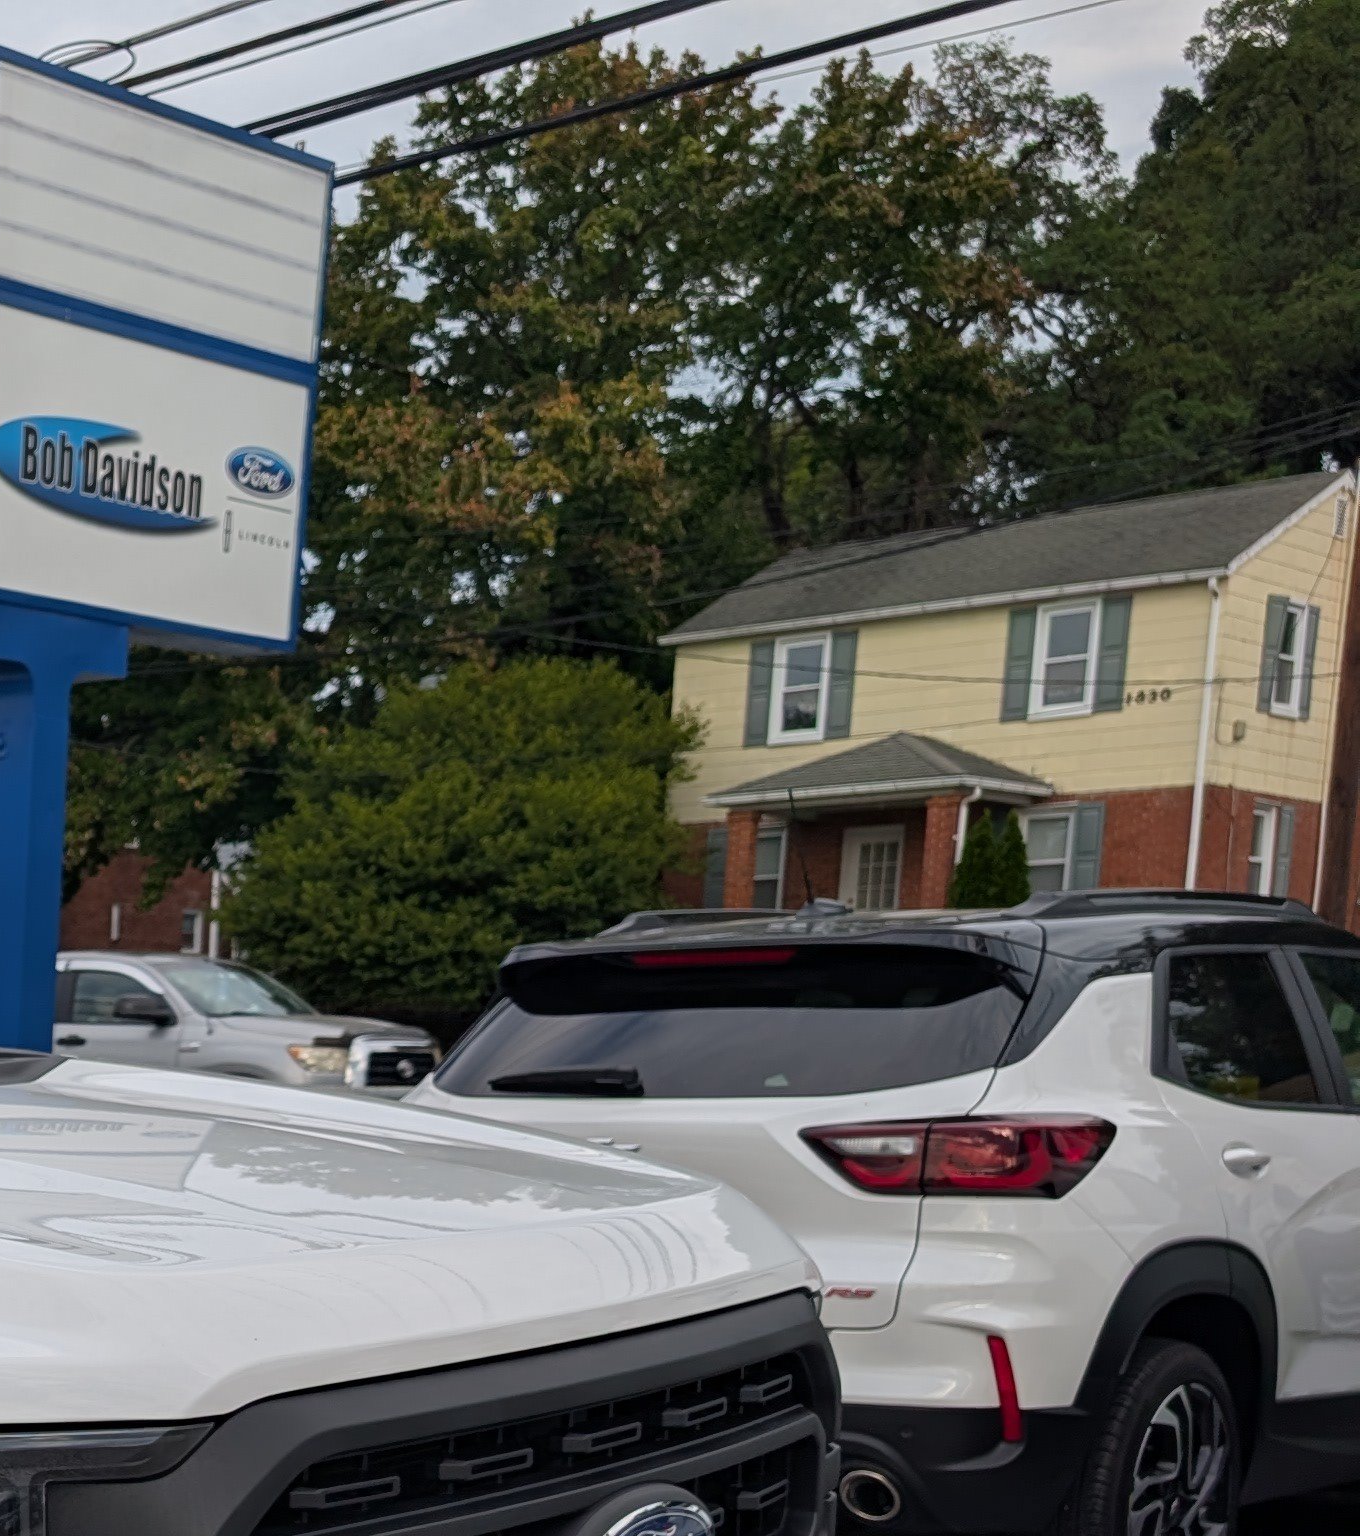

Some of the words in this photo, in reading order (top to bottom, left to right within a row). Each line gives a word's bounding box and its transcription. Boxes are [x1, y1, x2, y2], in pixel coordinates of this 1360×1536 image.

[22, 425, 74, 490] Bob
[83, 439, 203, 518] Davidson
[236, 452, 285, 492] Ford
[237, 528, 290, 549] LINCOLN
[825, 1286, 876, 1299] RS
